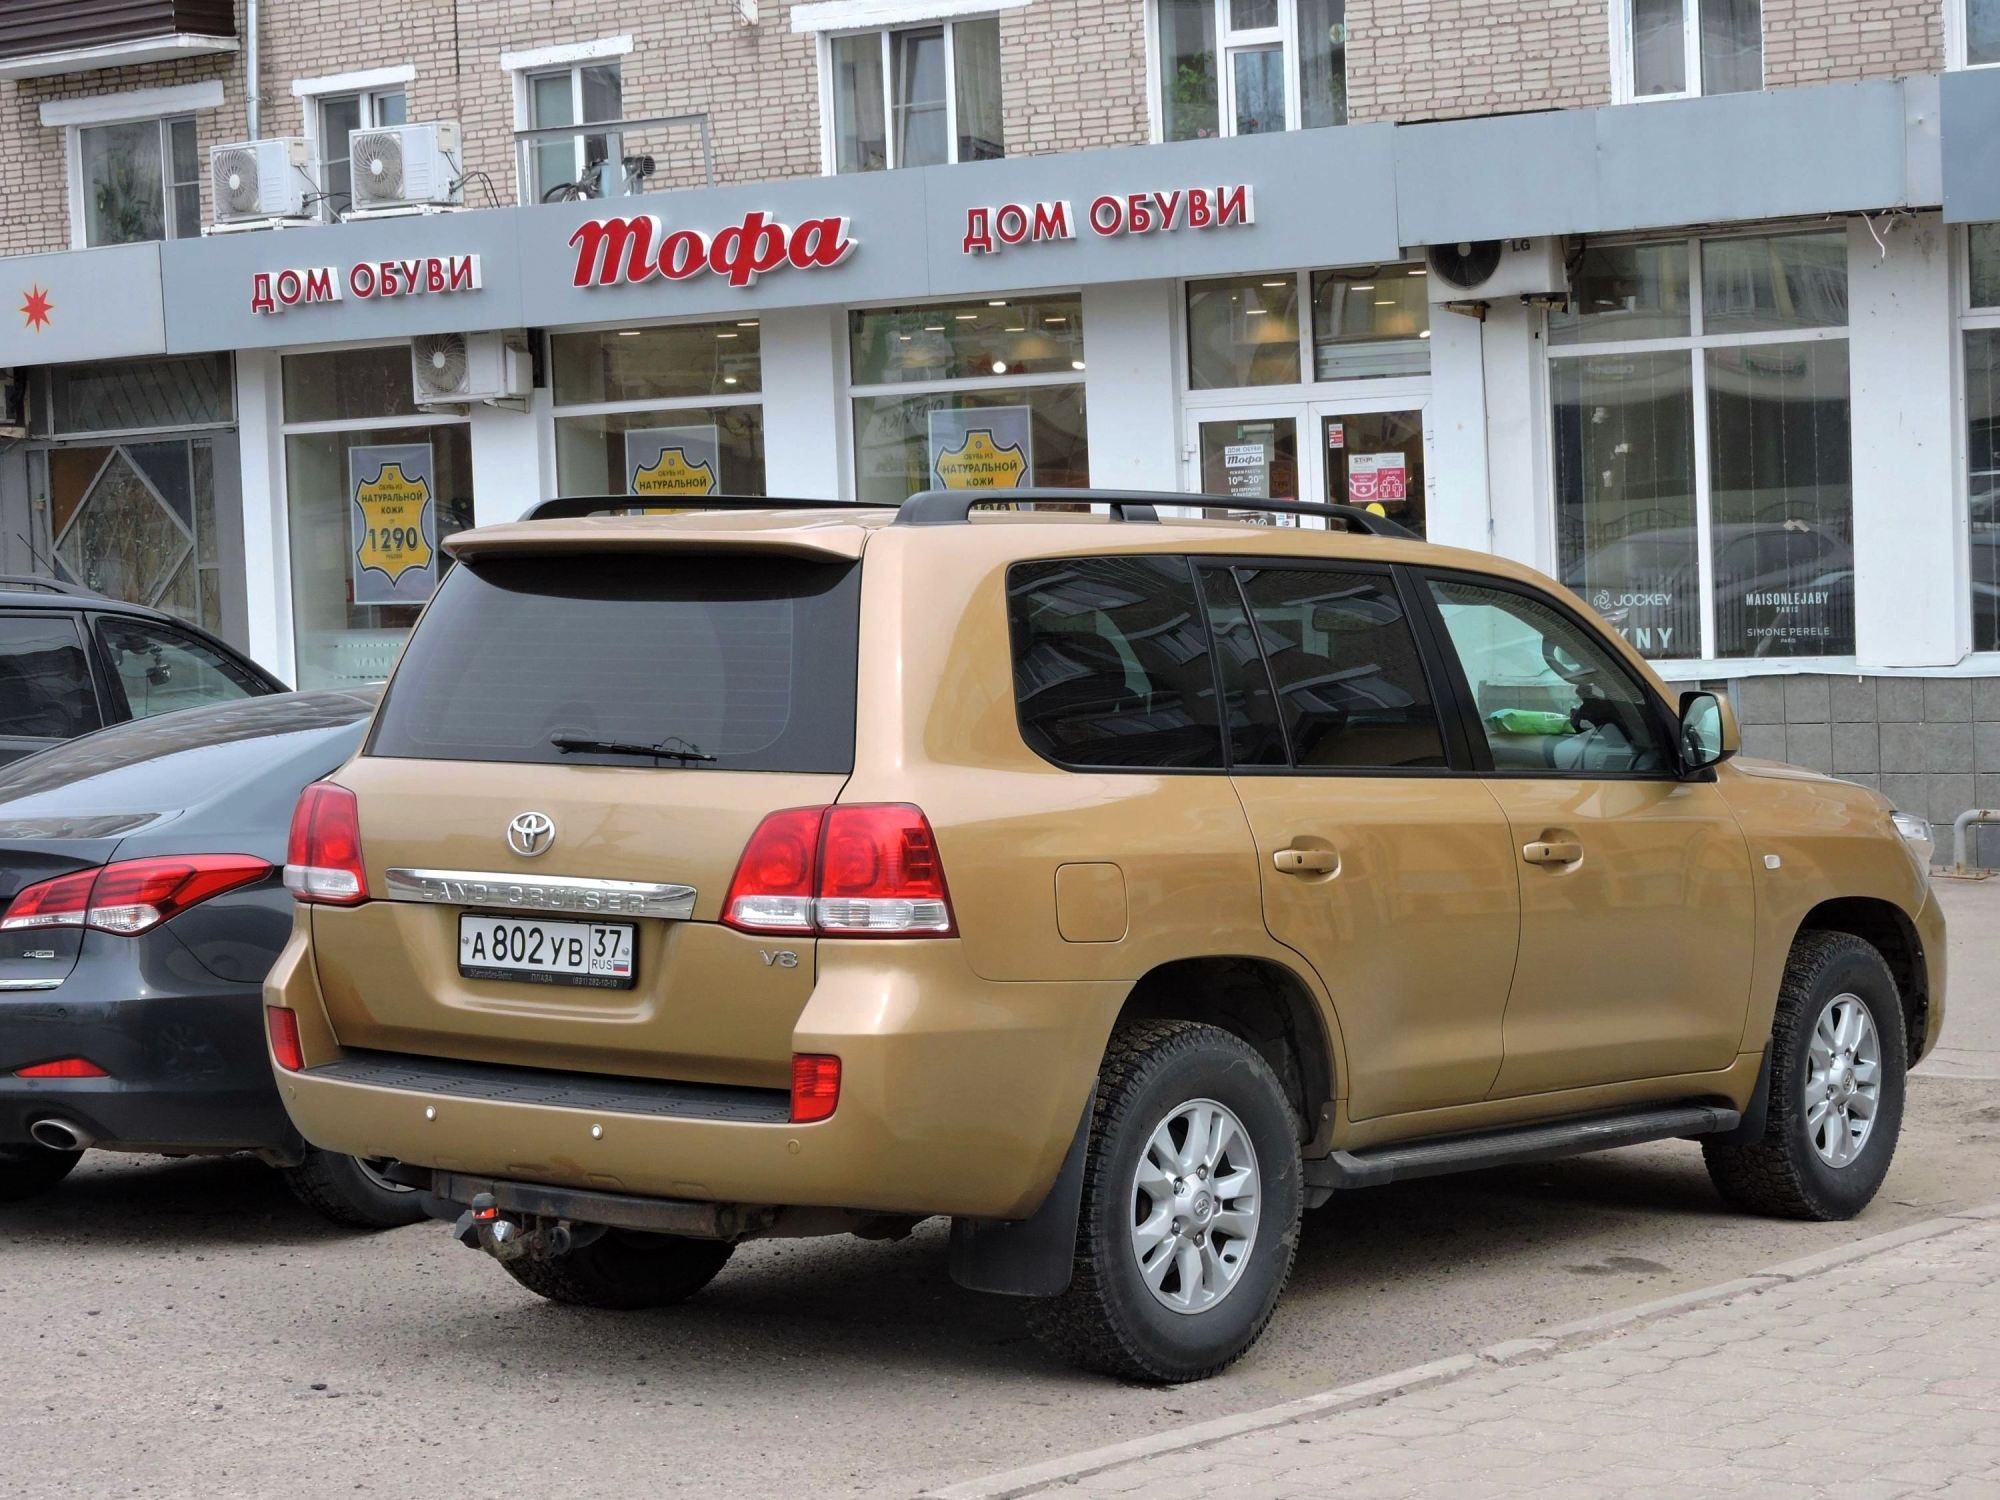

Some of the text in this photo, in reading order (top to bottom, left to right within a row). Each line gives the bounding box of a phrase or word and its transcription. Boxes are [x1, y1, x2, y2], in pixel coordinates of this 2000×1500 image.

[962, 184, 1254, 254] ДОМ ОБУВИ
[568, 210, 857, 287] Тофа
[1512, 239, 1531, 252] LG
[251, 254, 482, 314] ДОМ ОБУВИ
[943, 460, 1017, 474] НАТУРАЛЬНОЙ
[1226, 455, 1262, 465] Тофа
[640, 476, 707, 490] НАТУРАЛЬНОЙ
[966, 478, 994, 487] КОЖИ
[361, 490, 423, 503] НАТУРАЛЬНОЙ
[381, 506, 404, 515] КОЖИ
[369, 527, 418, 551] 1290
[1613, 593, 1672, 607] JOCKEY
[1746, 591, 1829, 606] MAISONLEJABY
[1747, 627, 1787, 637] SIMONE
[421, 880, 645, 914] LAND CRUISER
[593, 928, 622, 959] 37
[591, 959, 612, 971] RUS
[760, 949, 798, 968] V8
